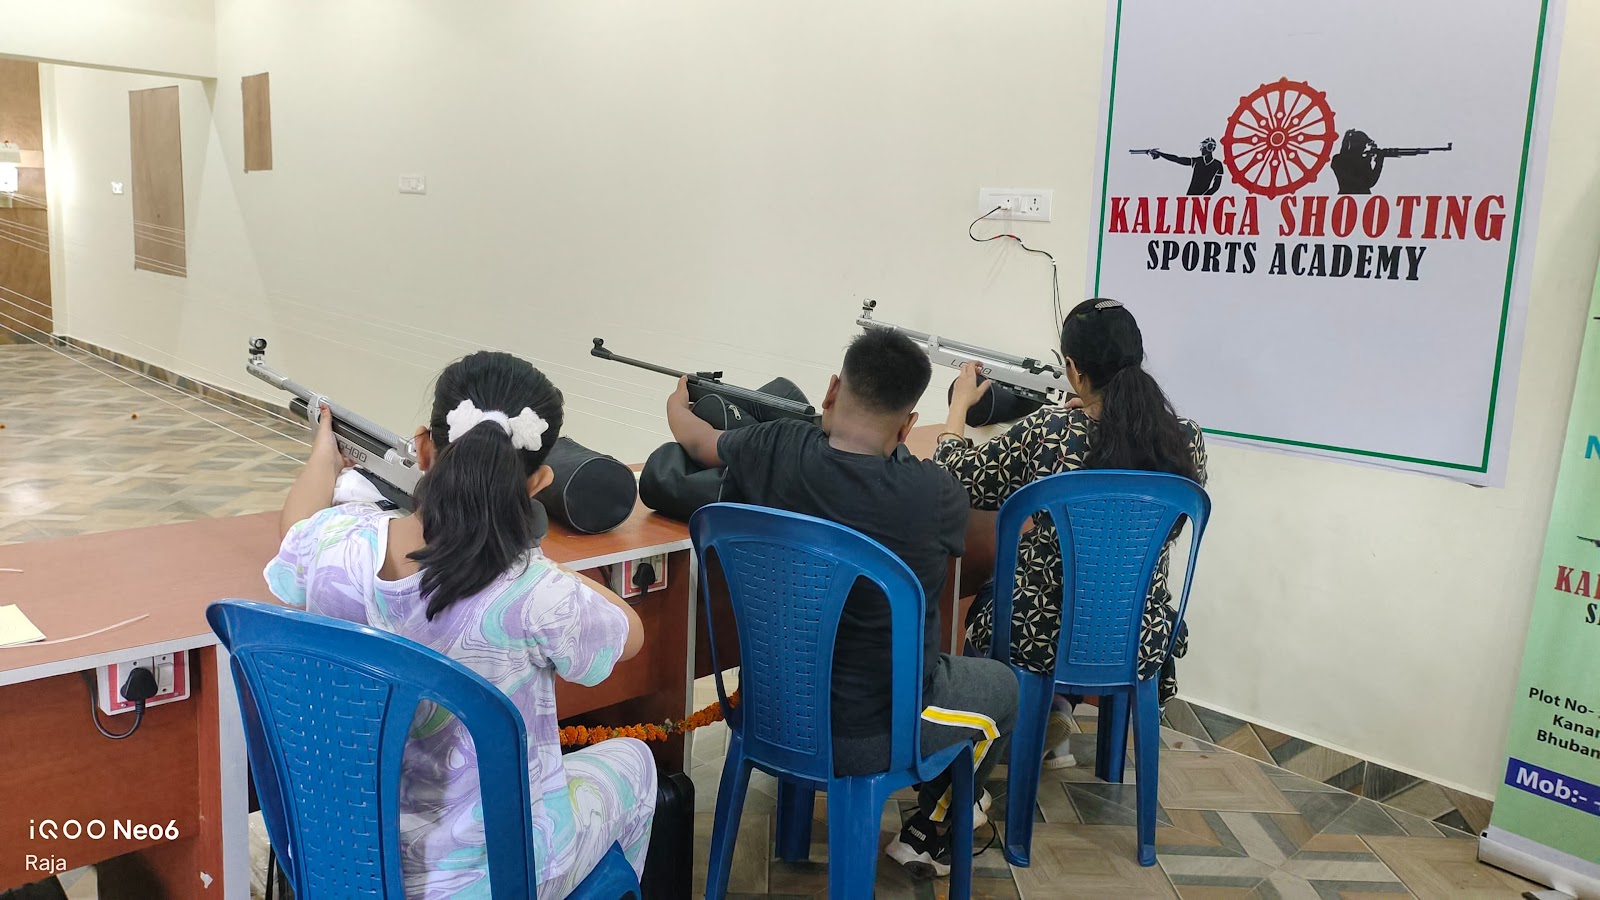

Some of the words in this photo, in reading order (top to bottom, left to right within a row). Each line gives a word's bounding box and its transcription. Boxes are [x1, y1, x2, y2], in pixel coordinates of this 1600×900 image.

[1108, 196, 1260, 236] KALINGA
[1278, 194, 1506, 241] SHOOTING
[1146, 240, 1257, 274] SPORTS
[1268, 243, 1427, 281] ACADEMY
[1585, 602, 1600, 626] S
[1529, 687, 1561, 707] Plot
[1564, 697, 1594, 714] No-
[1516, 766, 1587, 803] Mob:-
